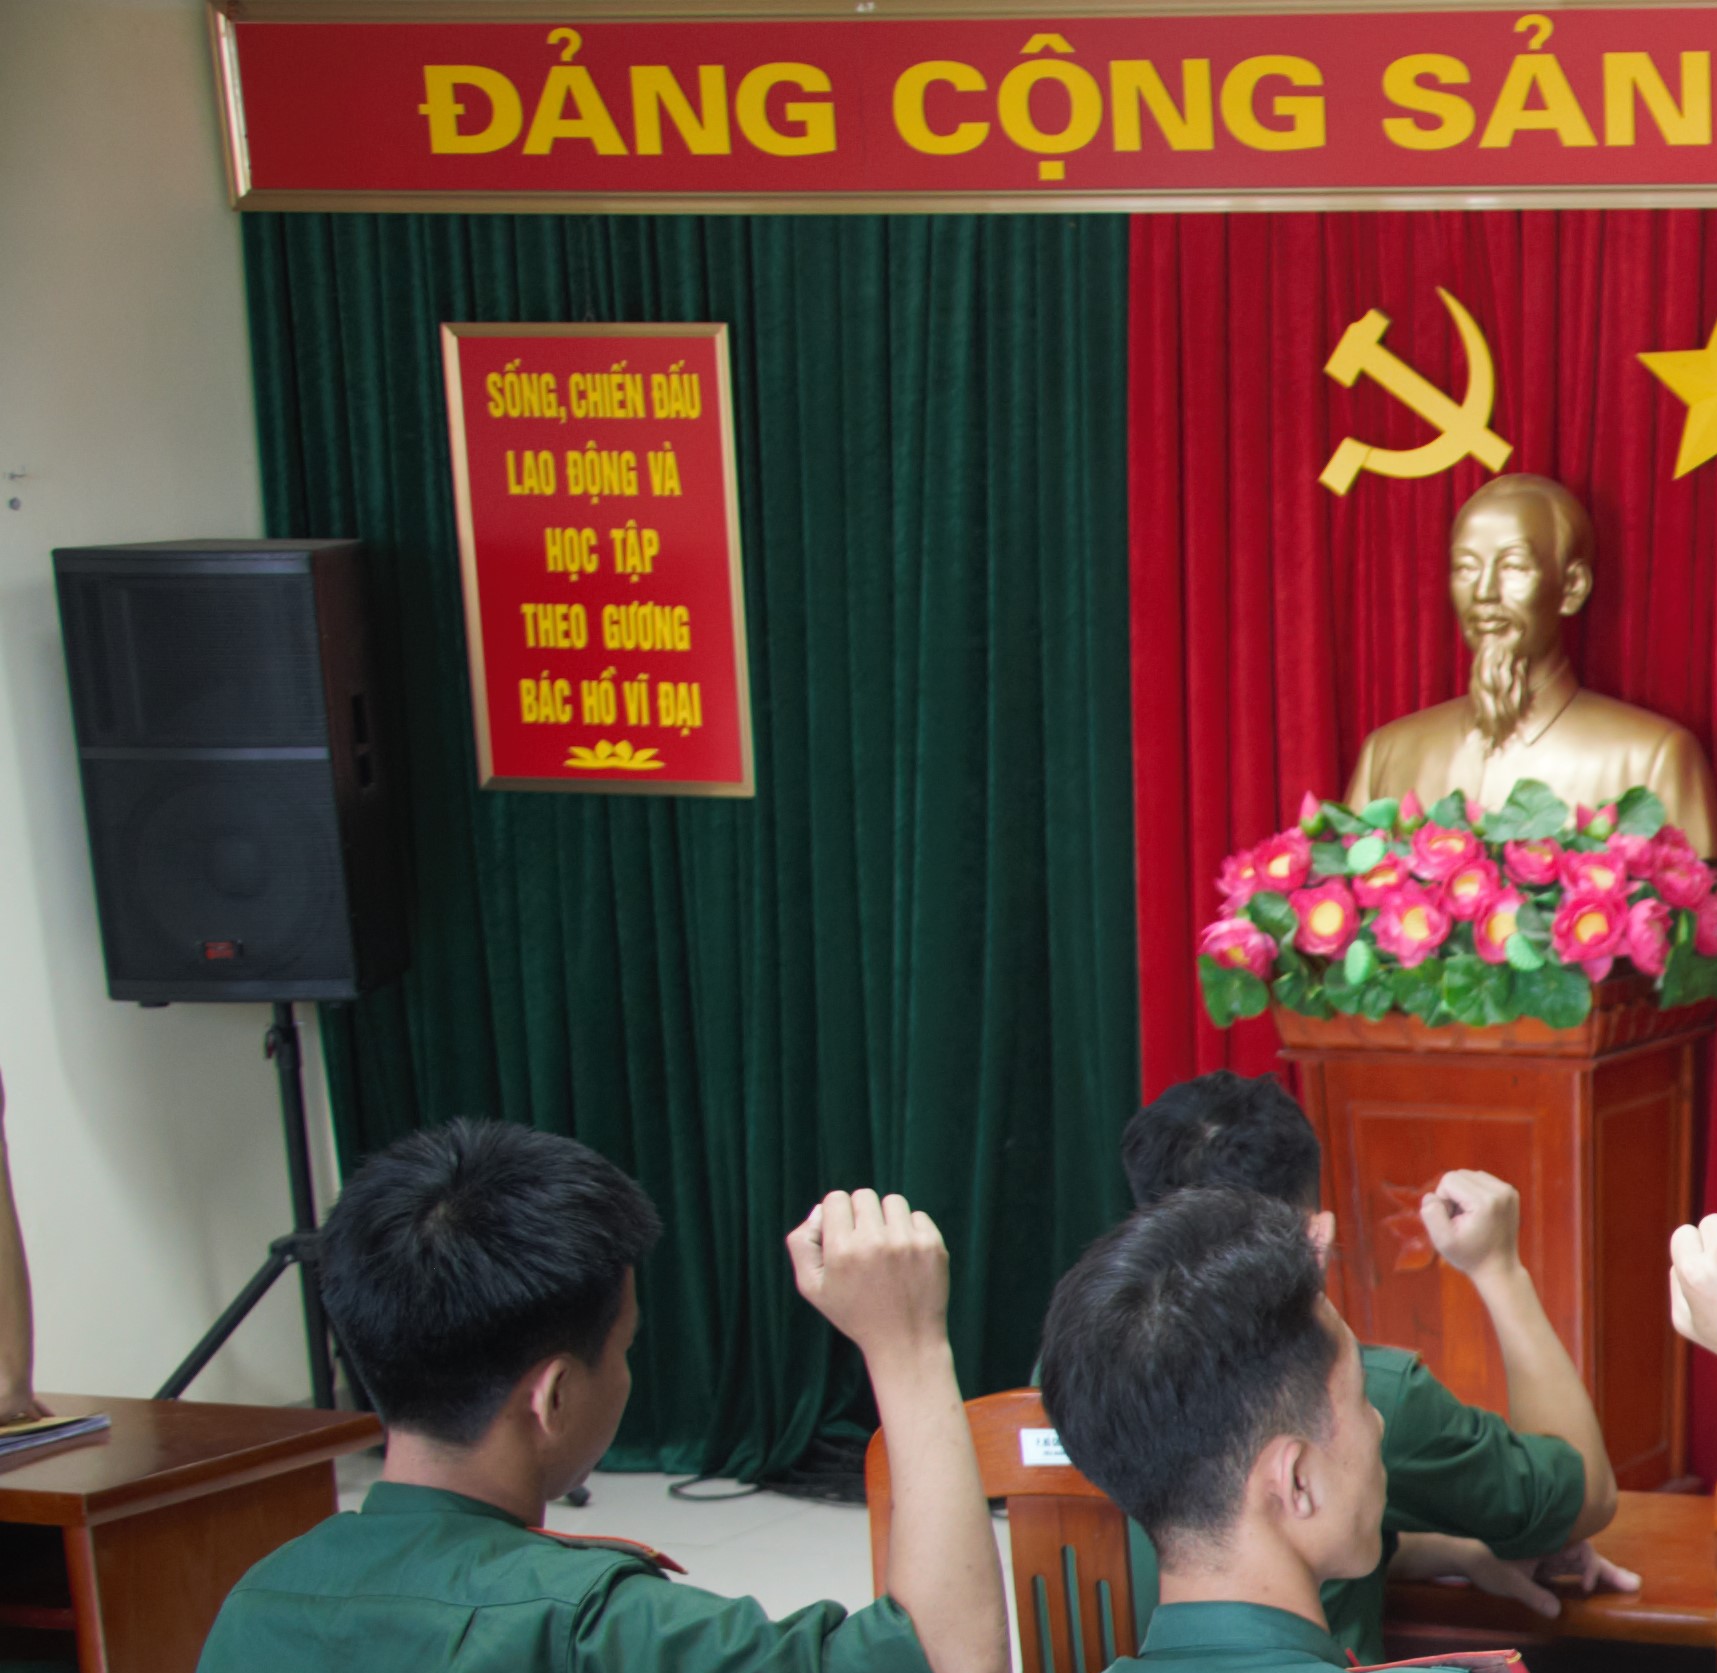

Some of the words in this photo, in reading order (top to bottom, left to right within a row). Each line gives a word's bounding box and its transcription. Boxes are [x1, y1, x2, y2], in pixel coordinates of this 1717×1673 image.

[418, 27, 837, 157] ĐẢNG
[892, 34, 1327, 181] CỘNG
[1381, 14, 1713, 151] SẢN
[486, 358, 567, 423] SỐNG,
[568, 360, 646, 419] CHIẾN
[651, 359, 702, 419] ĐẤU
[506, 450, 557, 496] LAO
[566, 440, 639, 504] ĐỘNG
[647, 441, 682, 497] VÀ
[545, 527, 599, 582] HỌC
[610, 519, 660, 583] TẬP
[521, 603, 588, 649] THEO
[602, 601, 691, 651] GƯƠNG
[520, 671, 572, 724] BÁC
[581, 667, 617, 726] HỒ
[623, 673, 650, 726] VĨ
[658, 682, 702, 736] ĐẠI
